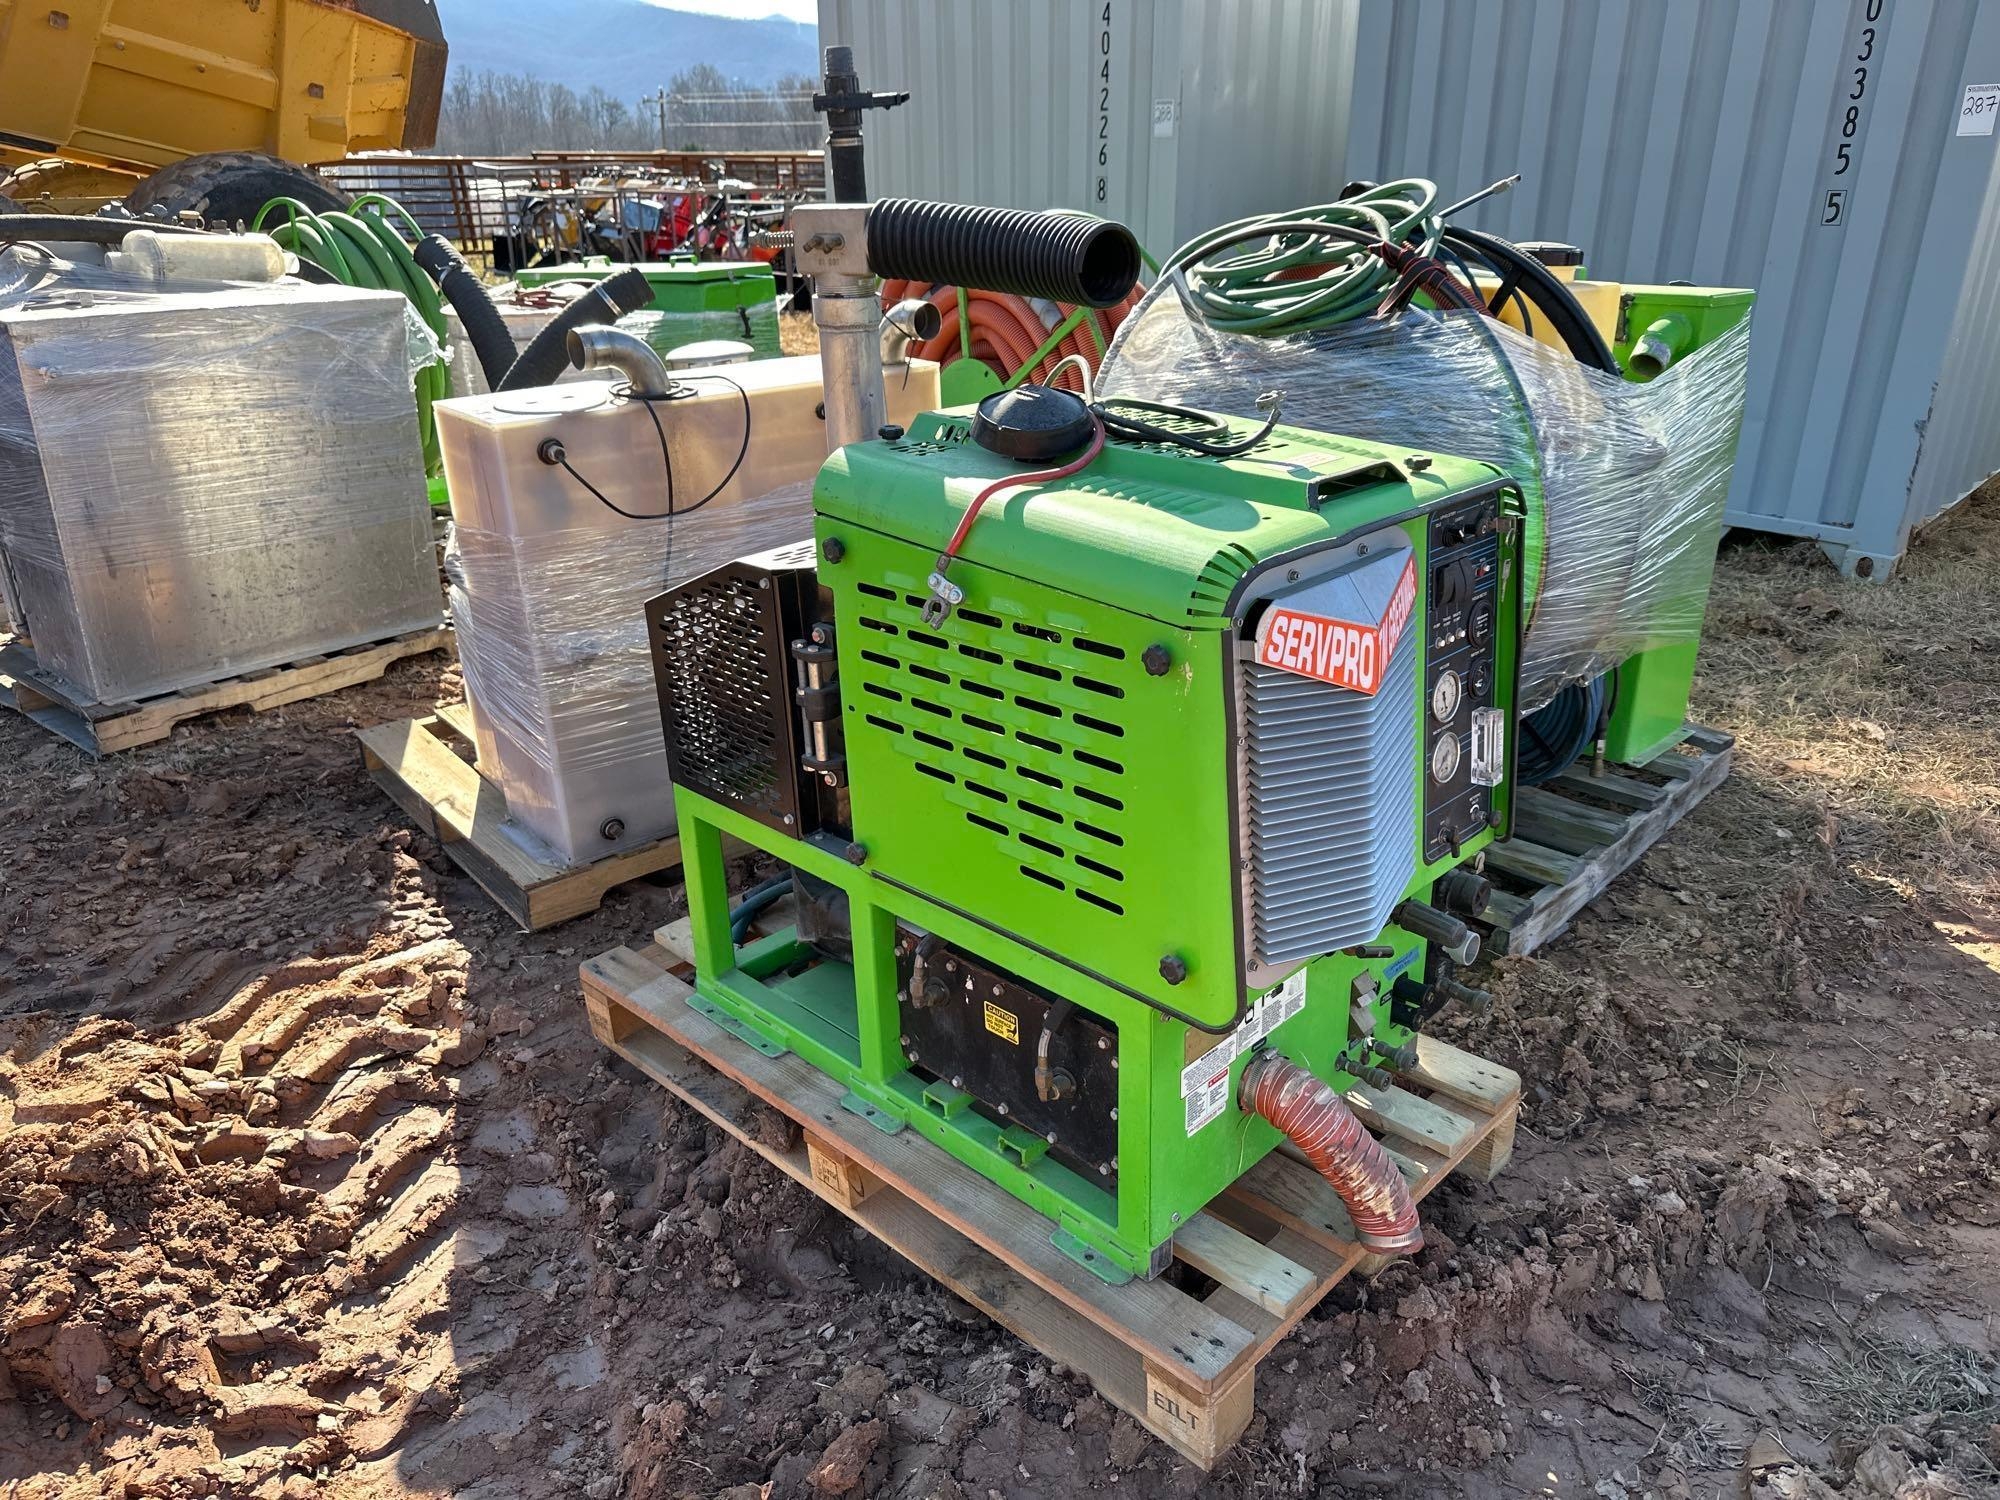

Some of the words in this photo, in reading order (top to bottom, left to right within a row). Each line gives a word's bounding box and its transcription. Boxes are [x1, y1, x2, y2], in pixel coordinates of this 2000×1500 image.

[1099, 1, 1111, 166] 404226
[1963, 95, 1998, 116] 287
[1097, 178, 1107, 201] 8
[1824, 192, 1842, 223] 5
[1267, 615, 1374, 690] SERVPRO
[987, 1005, 1016, 1024] CAUTION
[988, 1023, 1004, 1035] TOUCH
